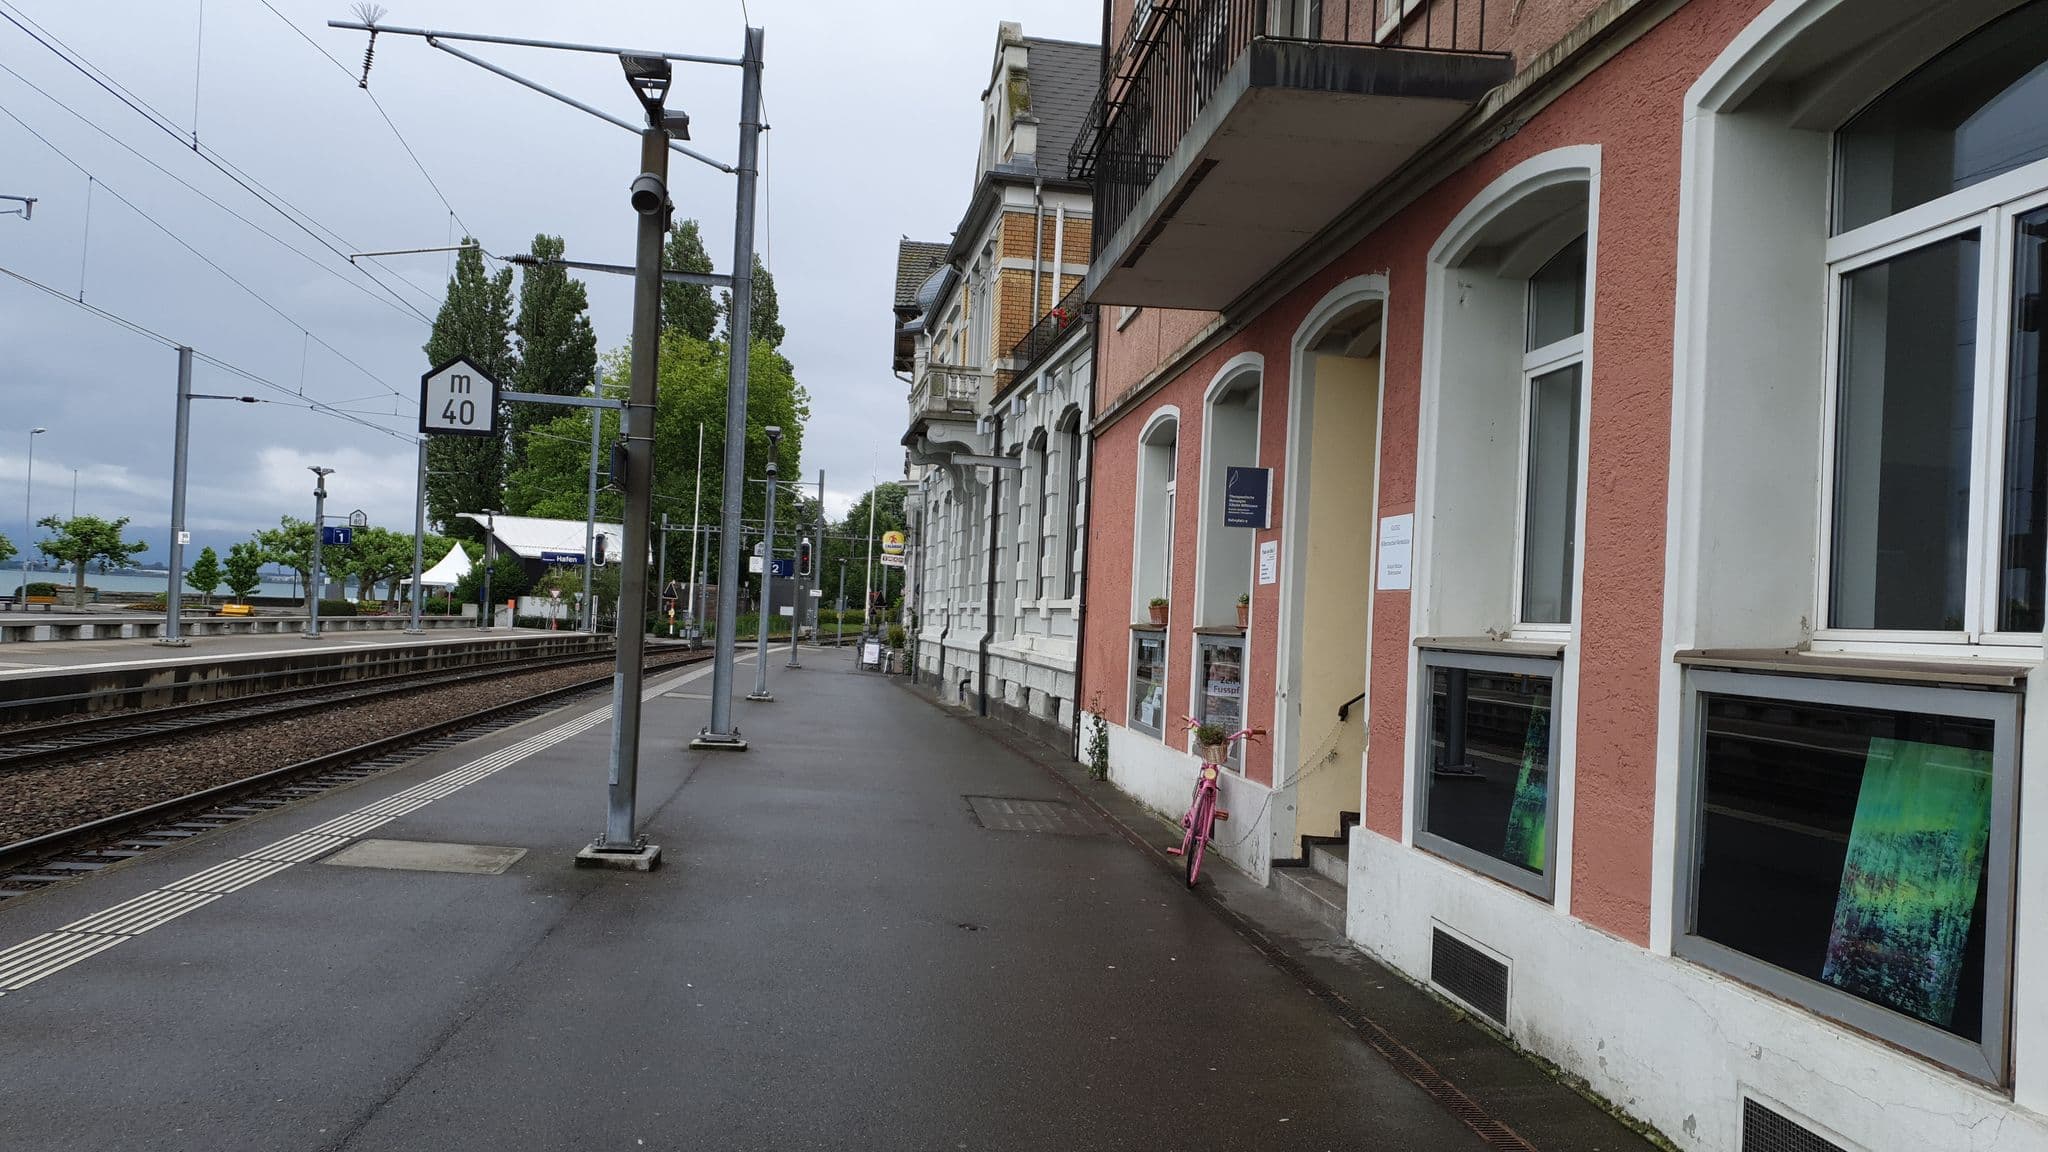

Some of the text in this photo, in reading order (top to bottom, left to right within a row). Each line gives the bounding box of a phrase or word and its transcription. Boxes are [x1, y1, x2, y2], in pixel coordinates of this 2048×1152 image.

[451, 374, 471, 394] m
[442, 399, 475, 425] 40
[339, 533, 344, 542] 1
[556, 555, 578, 563] Hafen
[772, 564, 779, 573] 2
